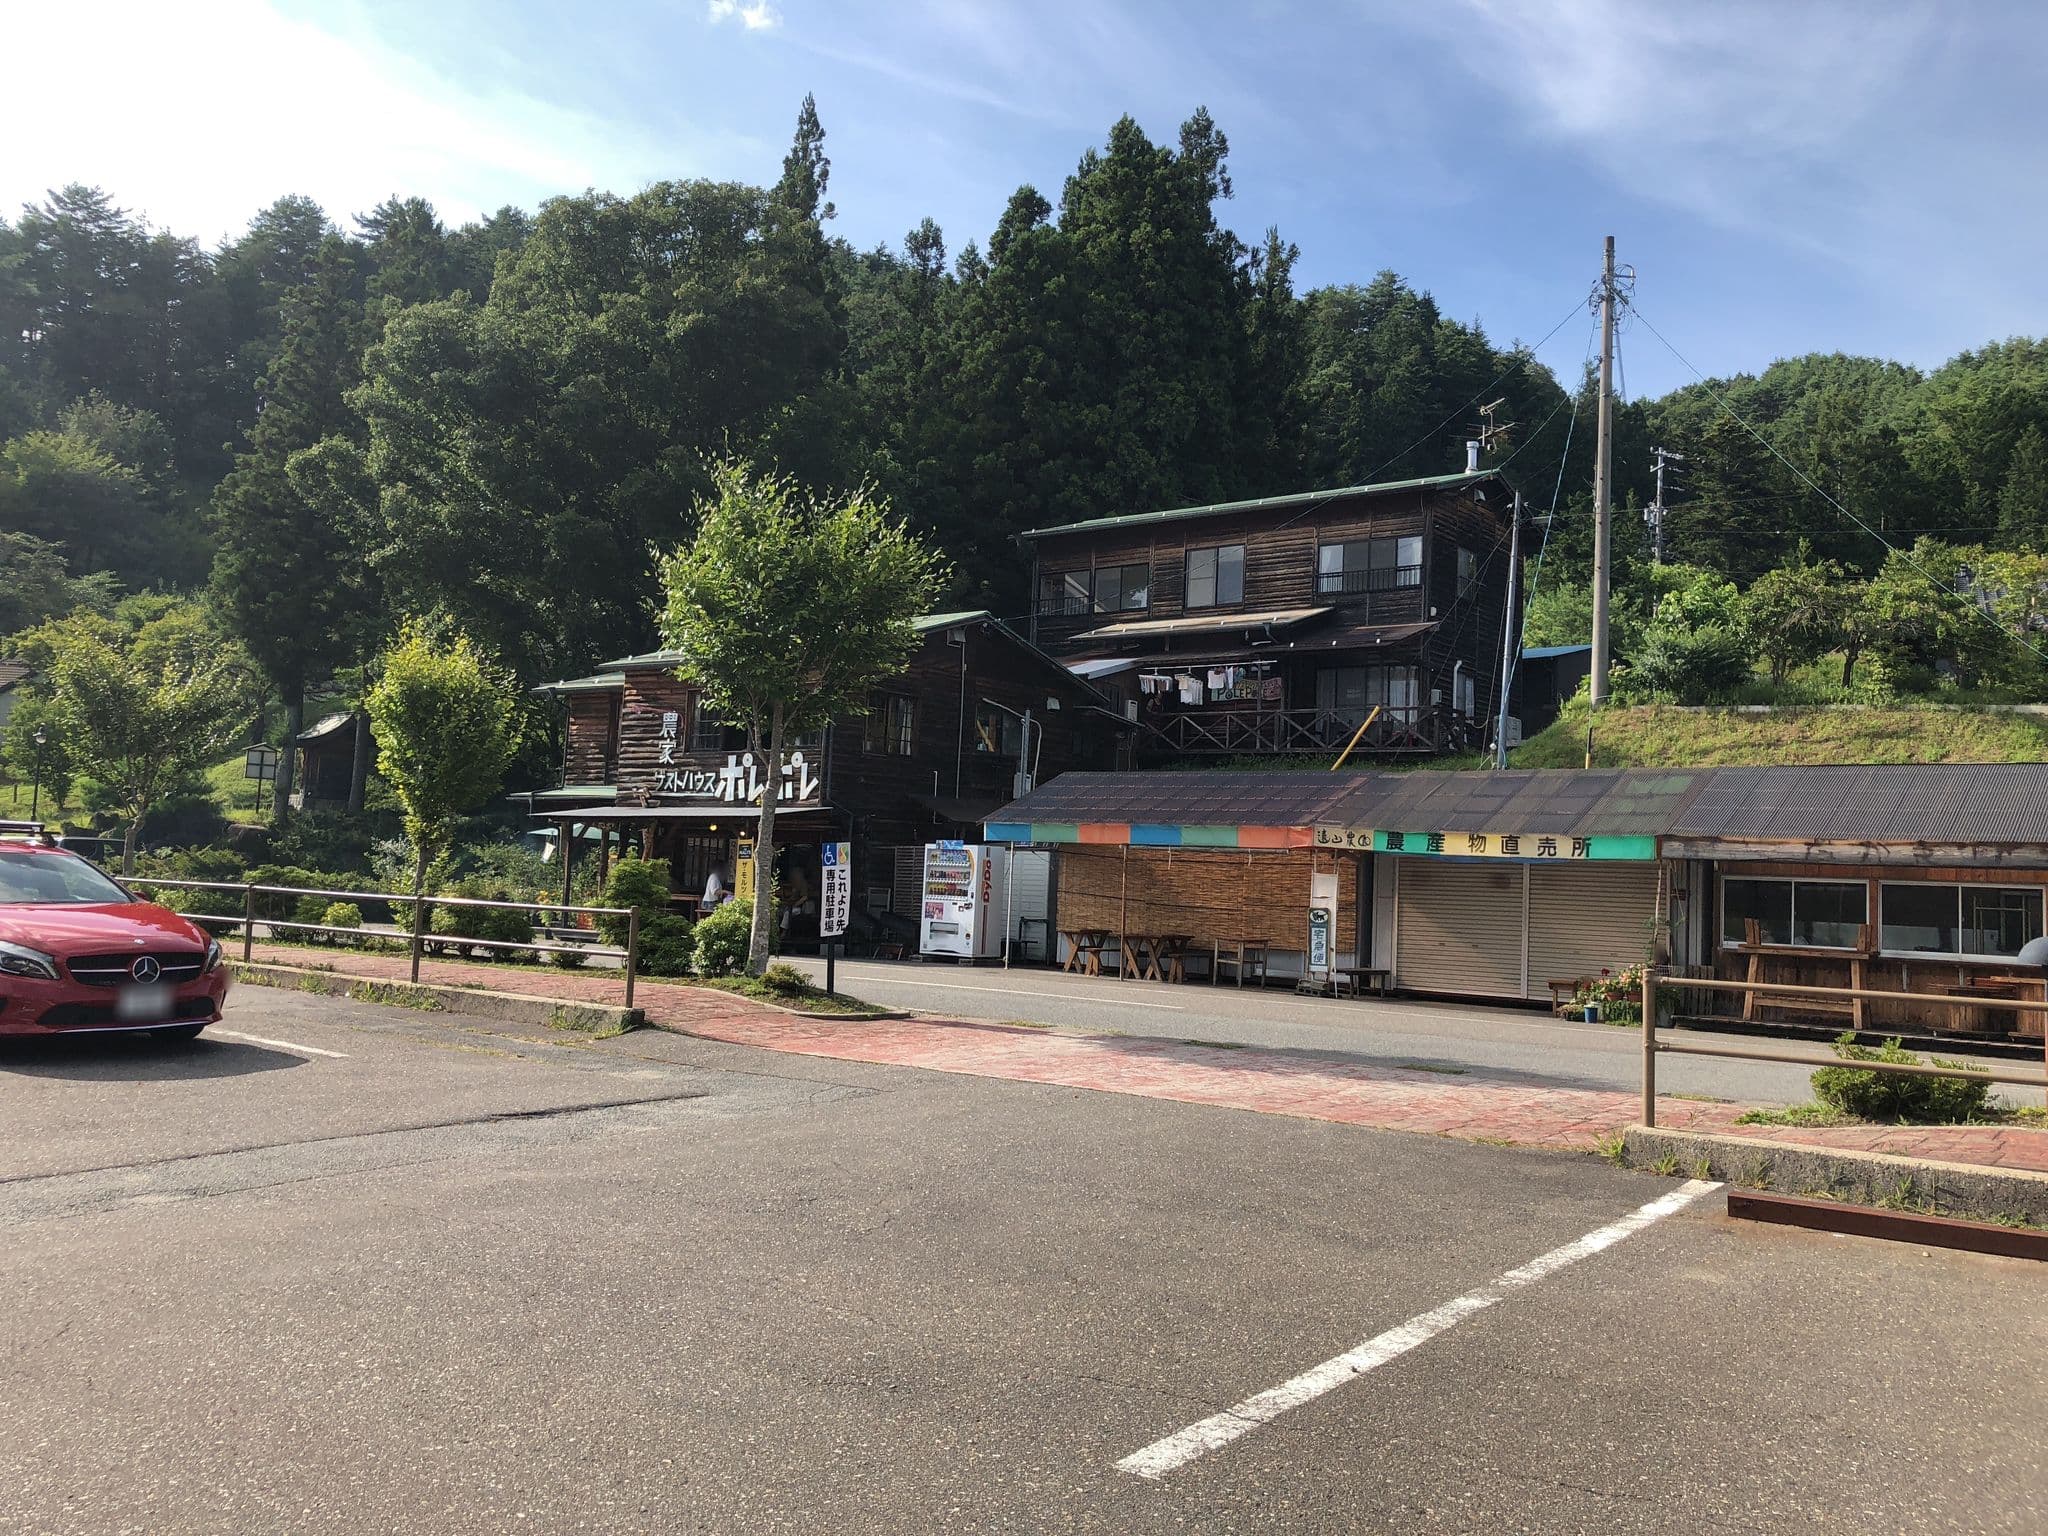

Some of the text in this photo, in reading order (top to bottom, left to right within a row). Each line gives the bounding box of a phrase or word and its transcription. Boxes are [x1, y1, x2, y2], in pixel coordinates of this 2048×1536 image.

[659, 711, 678, 765] 農家
[655, 770, 716, 793] ゲストハウス
[1386, 831, 1592, 858] 農産物直売所
[825, 869, 836, 932] 専用駐車場
[836, 869, 847, 932] これより先
[983, 860, 992, 903] DyDo
[1313, 929, 1325, 963] 宅急便
